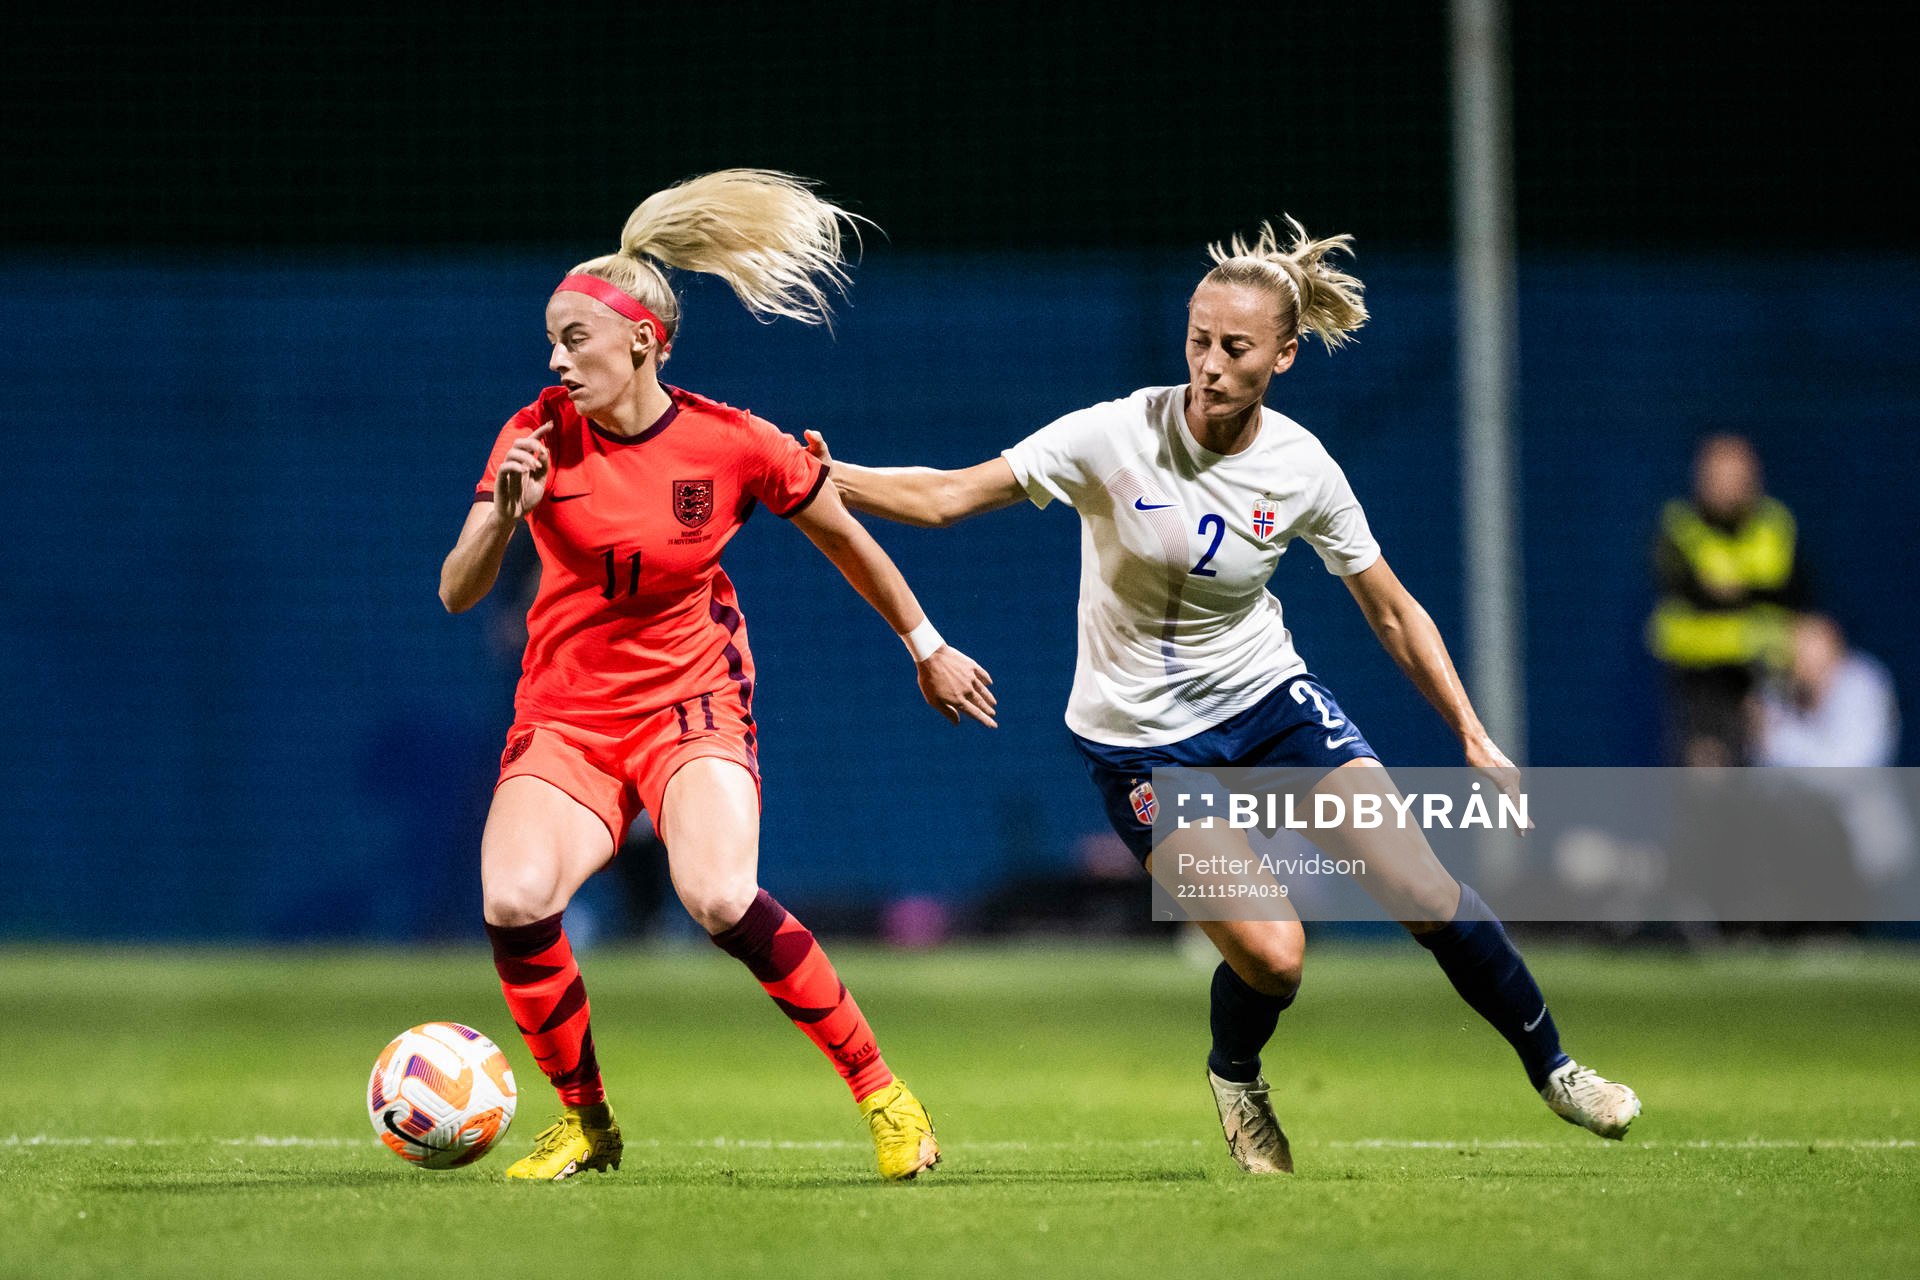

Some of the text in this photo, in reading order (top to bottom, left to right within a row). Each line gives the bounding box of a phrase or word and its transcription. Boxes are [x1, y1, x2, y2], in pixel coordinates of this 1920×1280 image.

[1189, 513, 1226, 578] 2
[600, 547, 641, 600] 11
[673, 695, 718, 735] 11
[1289, 680, 1344, 729] 2
